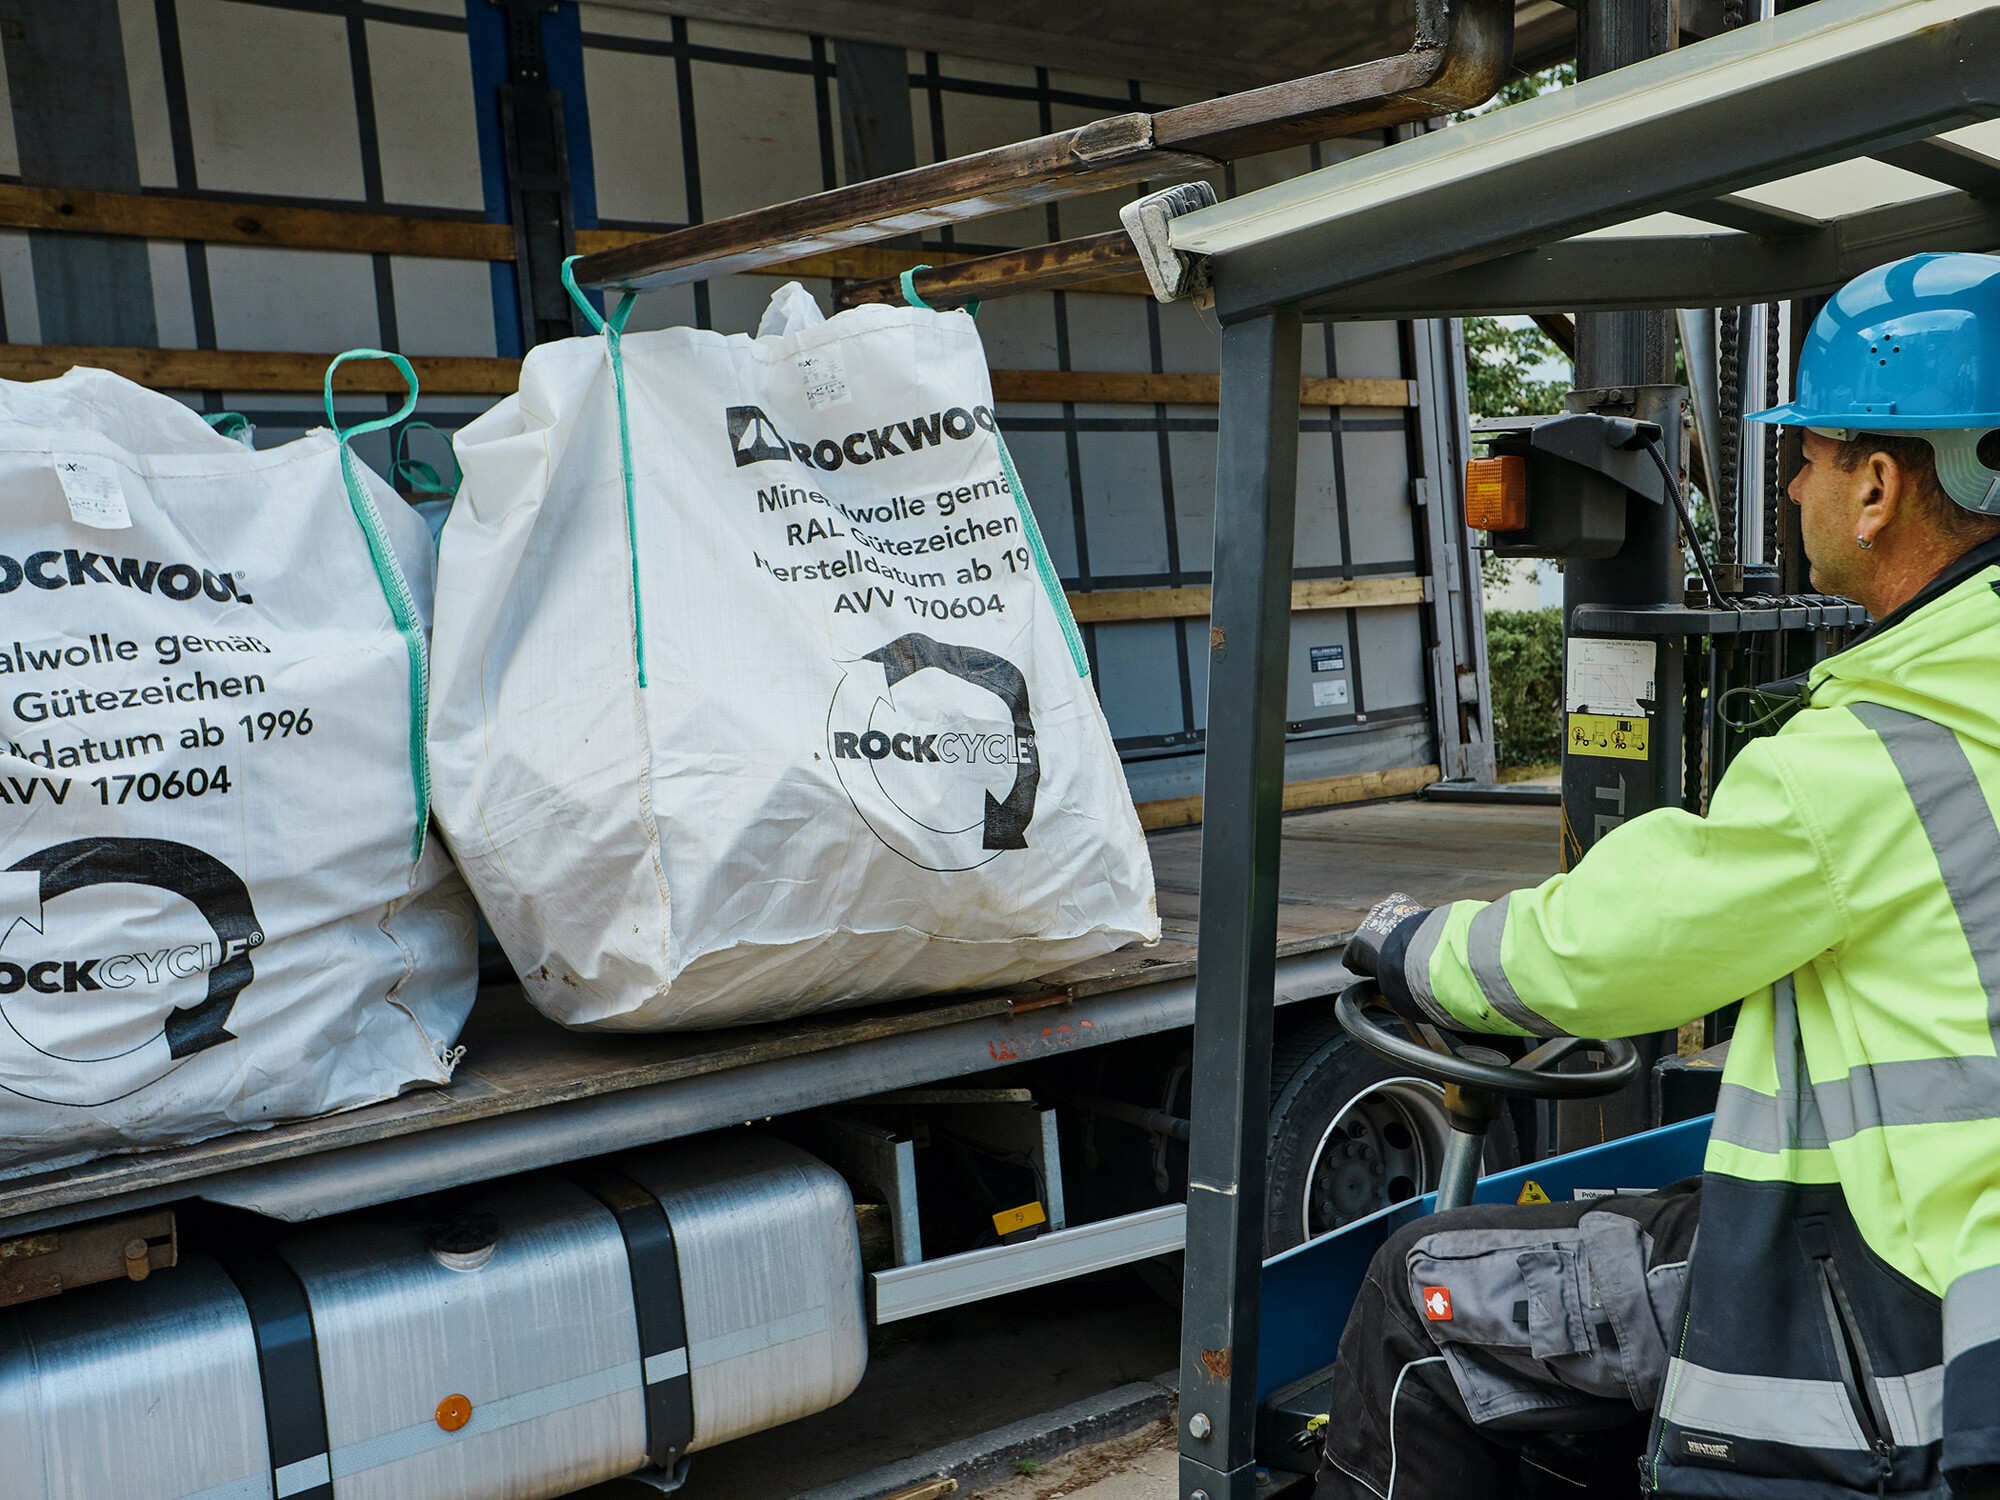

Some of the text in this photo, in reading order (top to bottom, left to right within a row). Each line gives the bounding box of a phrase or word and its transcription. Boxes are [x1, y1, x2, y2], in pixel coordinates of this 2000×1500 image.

[788, 405, 996, 471] ROCKWOO
[786, 517, 844, 546] RAL
[851, 516, 1018, 556] Gütezeichen
[957, 558, 992, 585] ab
[834, 586, 1005, 620] AVV 170604
[13, 671, 266, 723] Gütezeichen
[180, 717, 225, 749] ab
[238, 708, 313, 742] 1996
[91, 765, 232, 805] 170604
